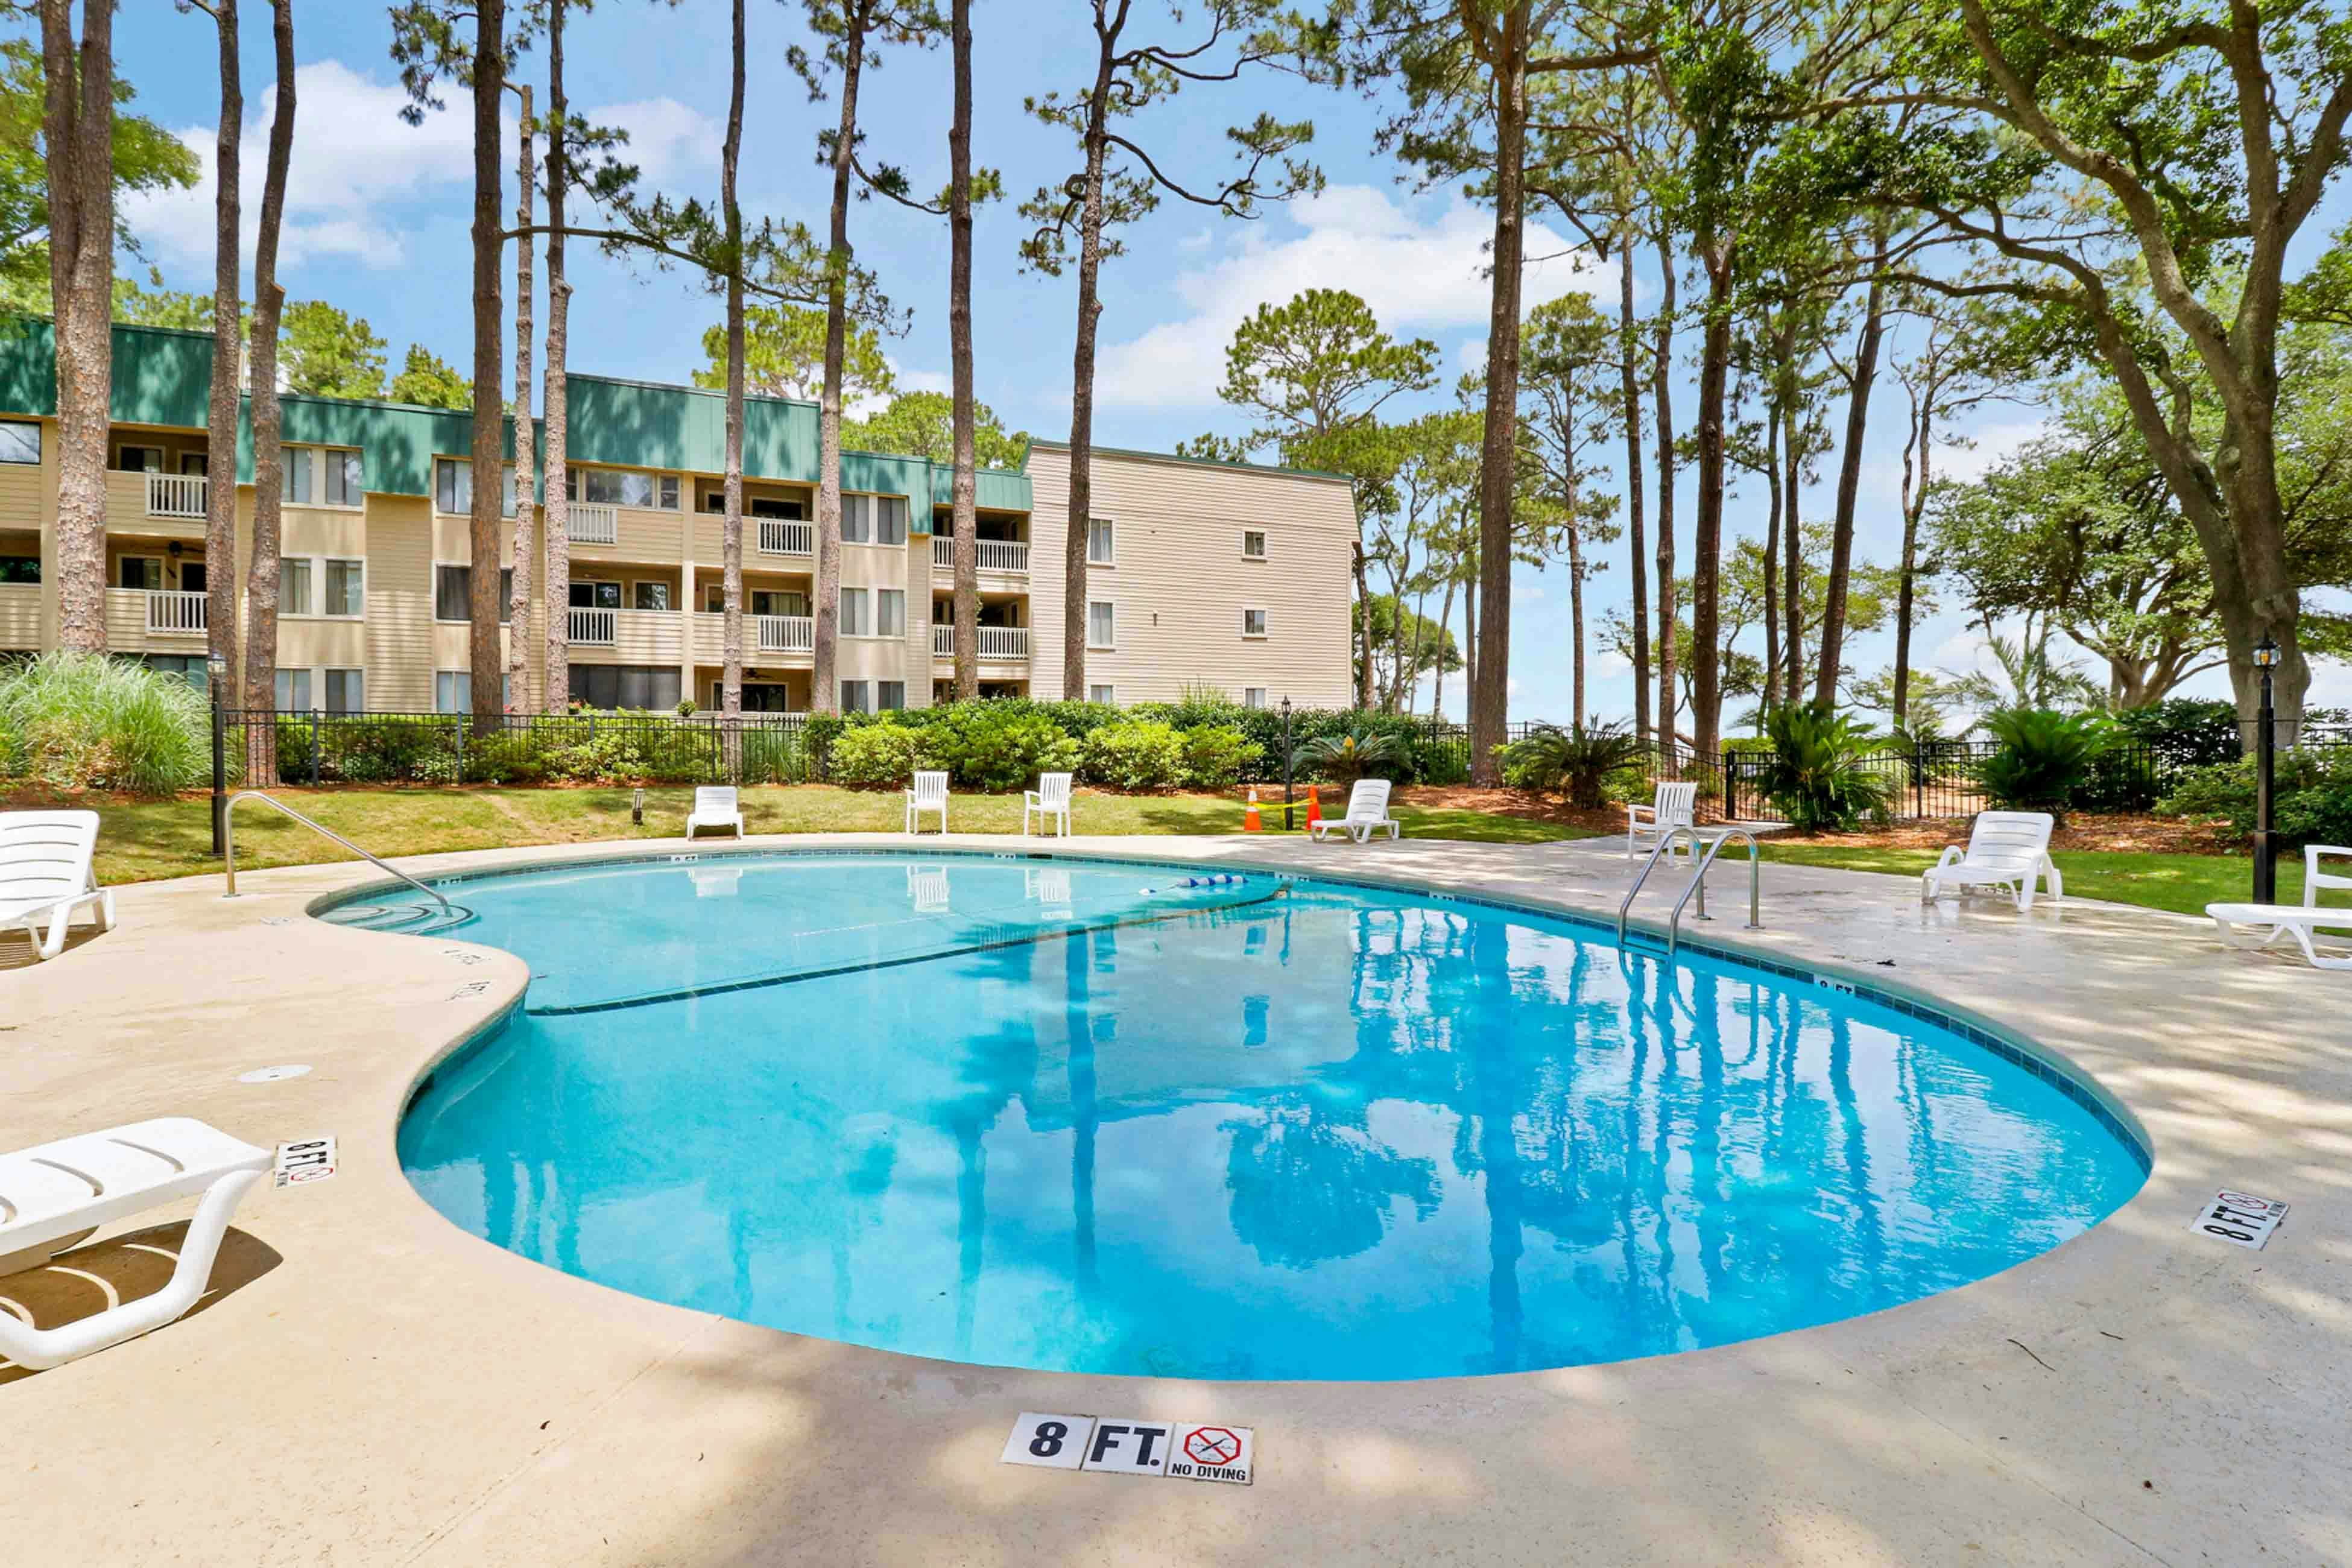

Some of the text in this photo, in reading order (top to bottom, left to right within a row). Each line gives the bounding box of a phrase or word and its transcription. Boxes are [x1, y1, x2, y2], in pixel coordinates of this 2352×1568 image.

[287, 1142, 326, 1151] 8
[2204, 1225, 2254, 1241] 8
[1029, 1421, 1166, 1466] 8 FT.
[1172, 1463, 1246, 1481] NO DIVING
